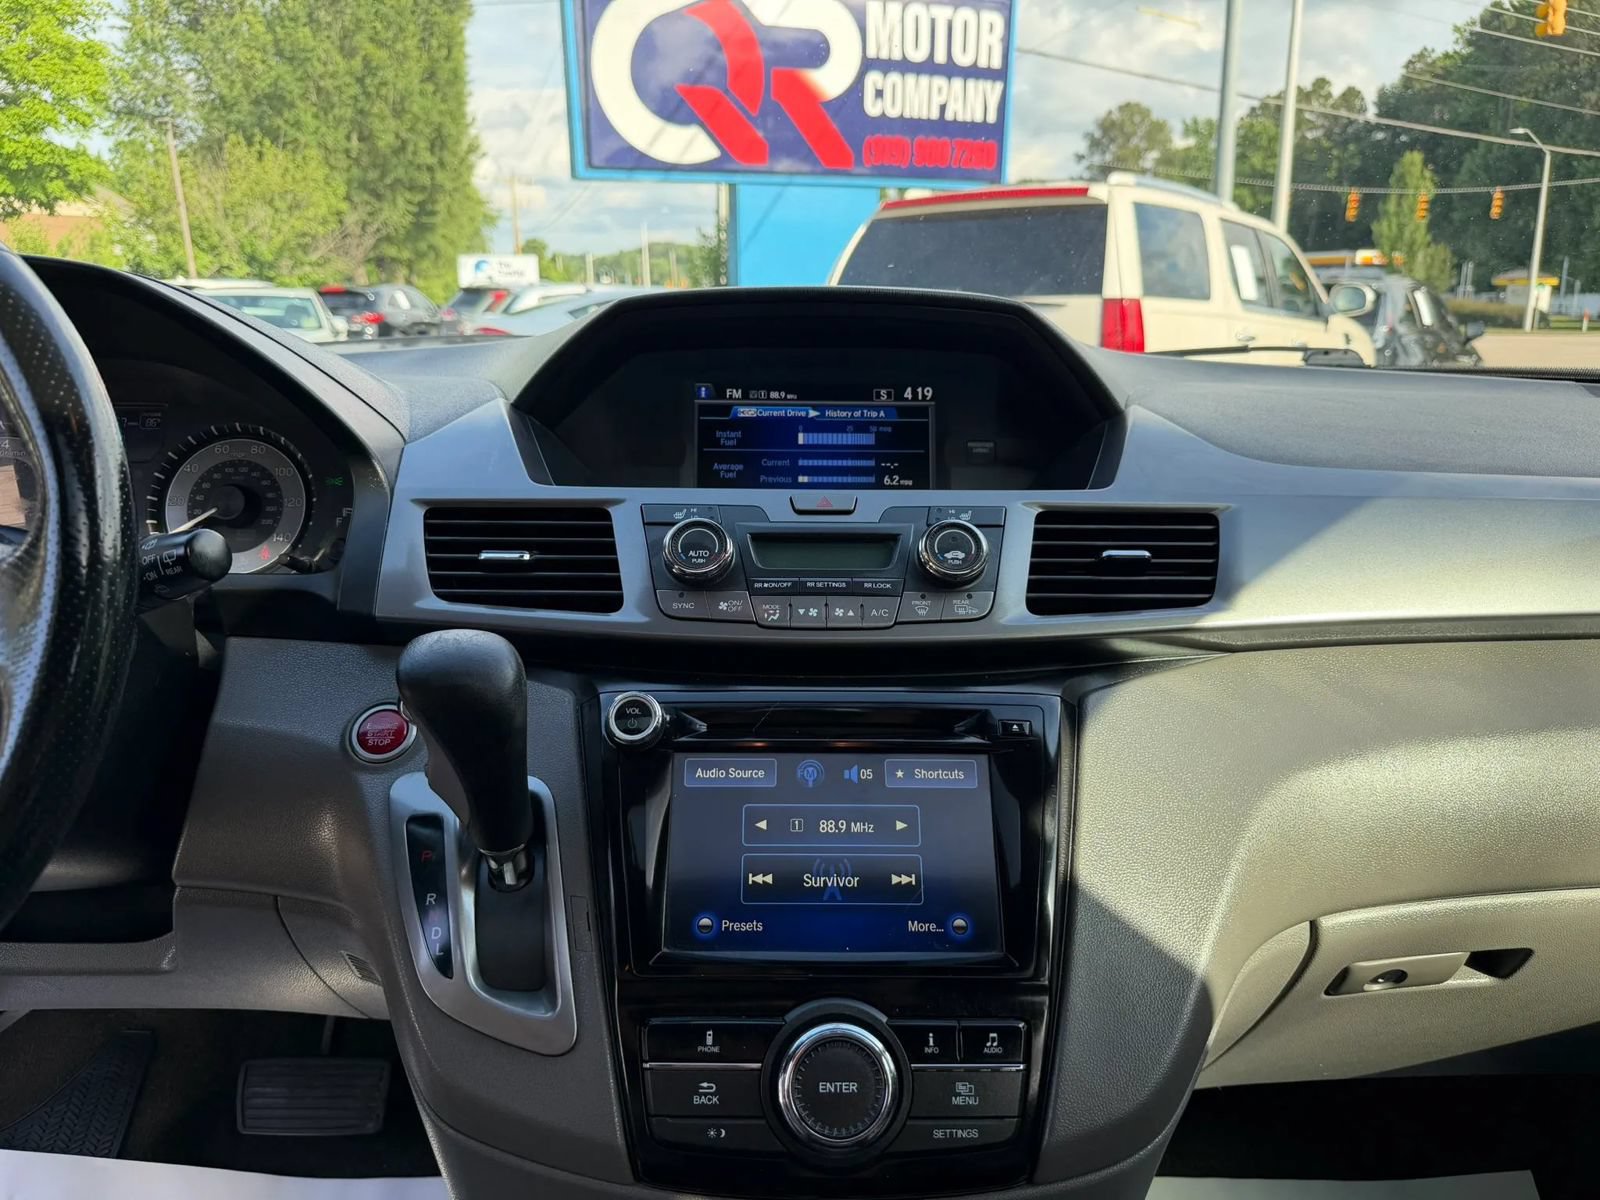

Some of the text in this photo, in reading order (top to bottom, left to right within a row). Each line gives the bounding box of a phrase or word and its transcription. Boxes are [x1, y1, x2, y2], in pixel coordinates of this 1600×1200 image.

[865, 2, 1005, 70] MOTOR
[863, 70, 1004, 124] COMPANY
[726, 389, 742, 399] FM
[770, 391, 786, 399] 88.9
[880, 390, 888, 400] S
[757, 409, 785, 417] Current
[787, 409, 806, 417] Drive
[825, 409, 852, 419] History
[853, 409, 862, 417] of
[863, 409, 878, 419] Trip
[715, 430, 742, 438] Instant
[720, 438, 737, 446] Fuel
[214, 445, 230, 454] 60
[250, 445, 266, 454] 80
[761, 458, 790, 466] Current
[184, 463, 199, 473] 40
[275, 467, 294, 477] 100
[713, 463, 744, 472] Average
[720, 470, 737, 478] Fuel
[760, 475, 792, 483] Previous
[884, 475, 900, 485] 6.2
[168, 497, 185, 506] 20
[284, 497, 303, 507] 120
[273, 533, 292, 542] 140
[141, 554, 156, 566] OFF
[871, 608, 889, 617] A/C
[625, 707, 642, 715] VOL
[695, 767, 765, 778] Audio Source
[860, 769, 873, 780] 05
[914, 768, 965, 780] Shortcuts
[819, 820, 847, 833] 88.9
[850, 822, 875, 833] MHz
[420, 849, 433, 863] P
[803, 873, 860, 888] Survivor
[425, 892, 437, 905] R
[721, 920, 763, 932] Presets
[431, 926, 442, 940] D
[435, 943, 445, 956] L
[924, 1046, 940, 1054] INFO
[983, 1046, 1003, 1054] AUDIO
[818, 1081, 858, 1094] ENTER
[693, 1095, 720, 1105] BACK
[951, 1095, 979, 1105] MENU
[932, 1128, 979, 1139] SETTINGS
